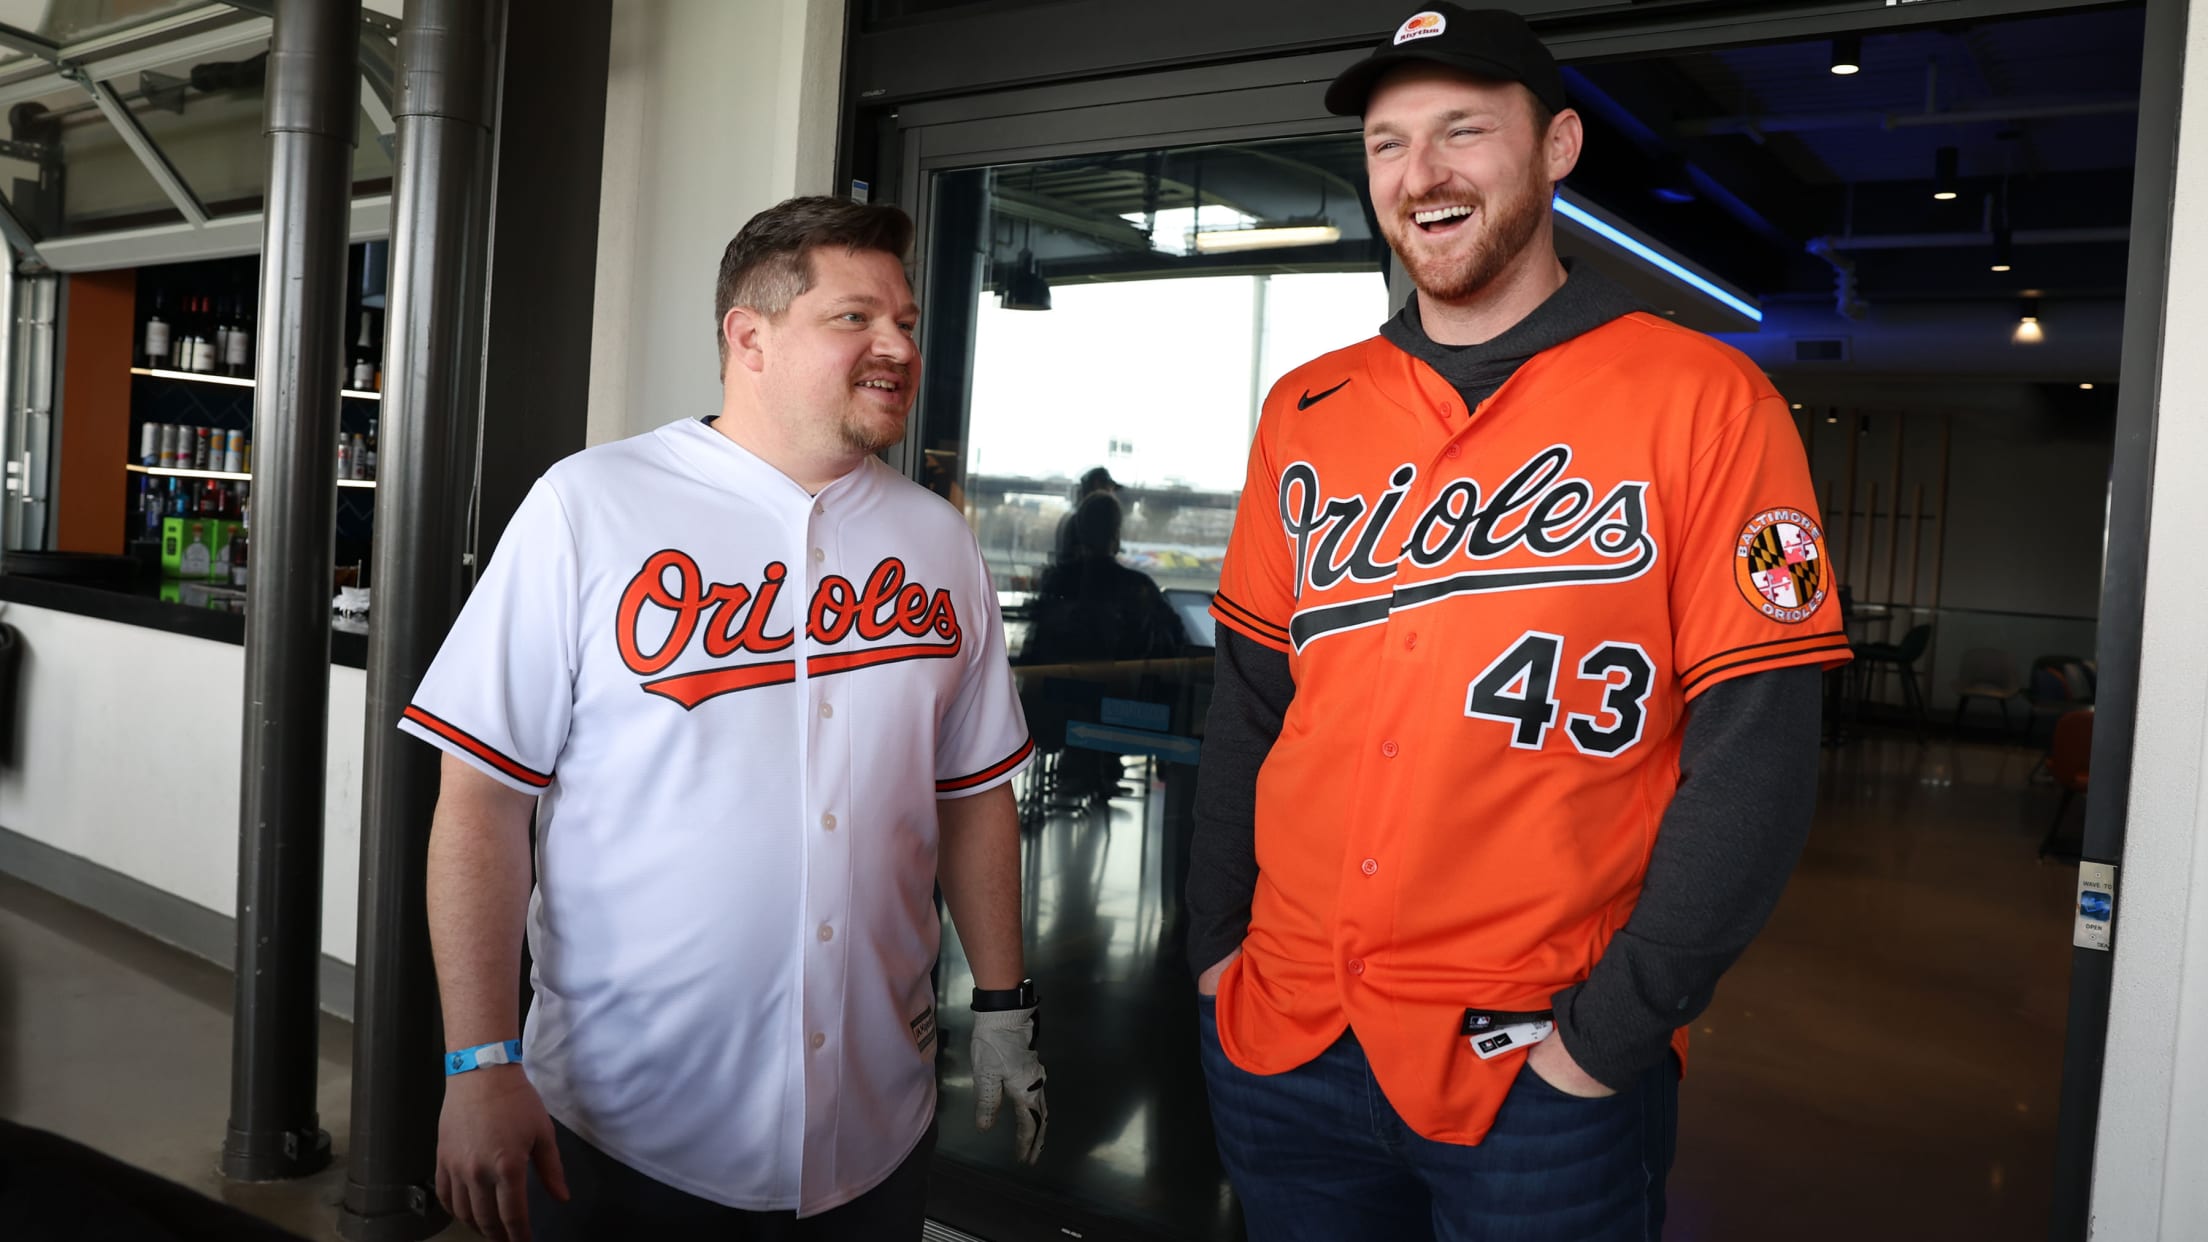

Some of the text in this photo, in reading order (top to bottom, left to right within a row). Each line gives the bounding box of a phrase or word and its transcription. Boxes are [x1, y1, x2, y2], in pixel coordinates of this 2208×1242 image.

[1279, 443, 1657, 602] Orioles
[1737, 510, 1820, 558] BALTIMORE
[616, 549, 963, 676] Orioles
[1762, 590, 1824, 620] ORIOLES
[1464, 629, 1656, 758] 43
[2083, 881, 2100, 889] WAVE
[2086, 923, 2102, 931] OPEN
